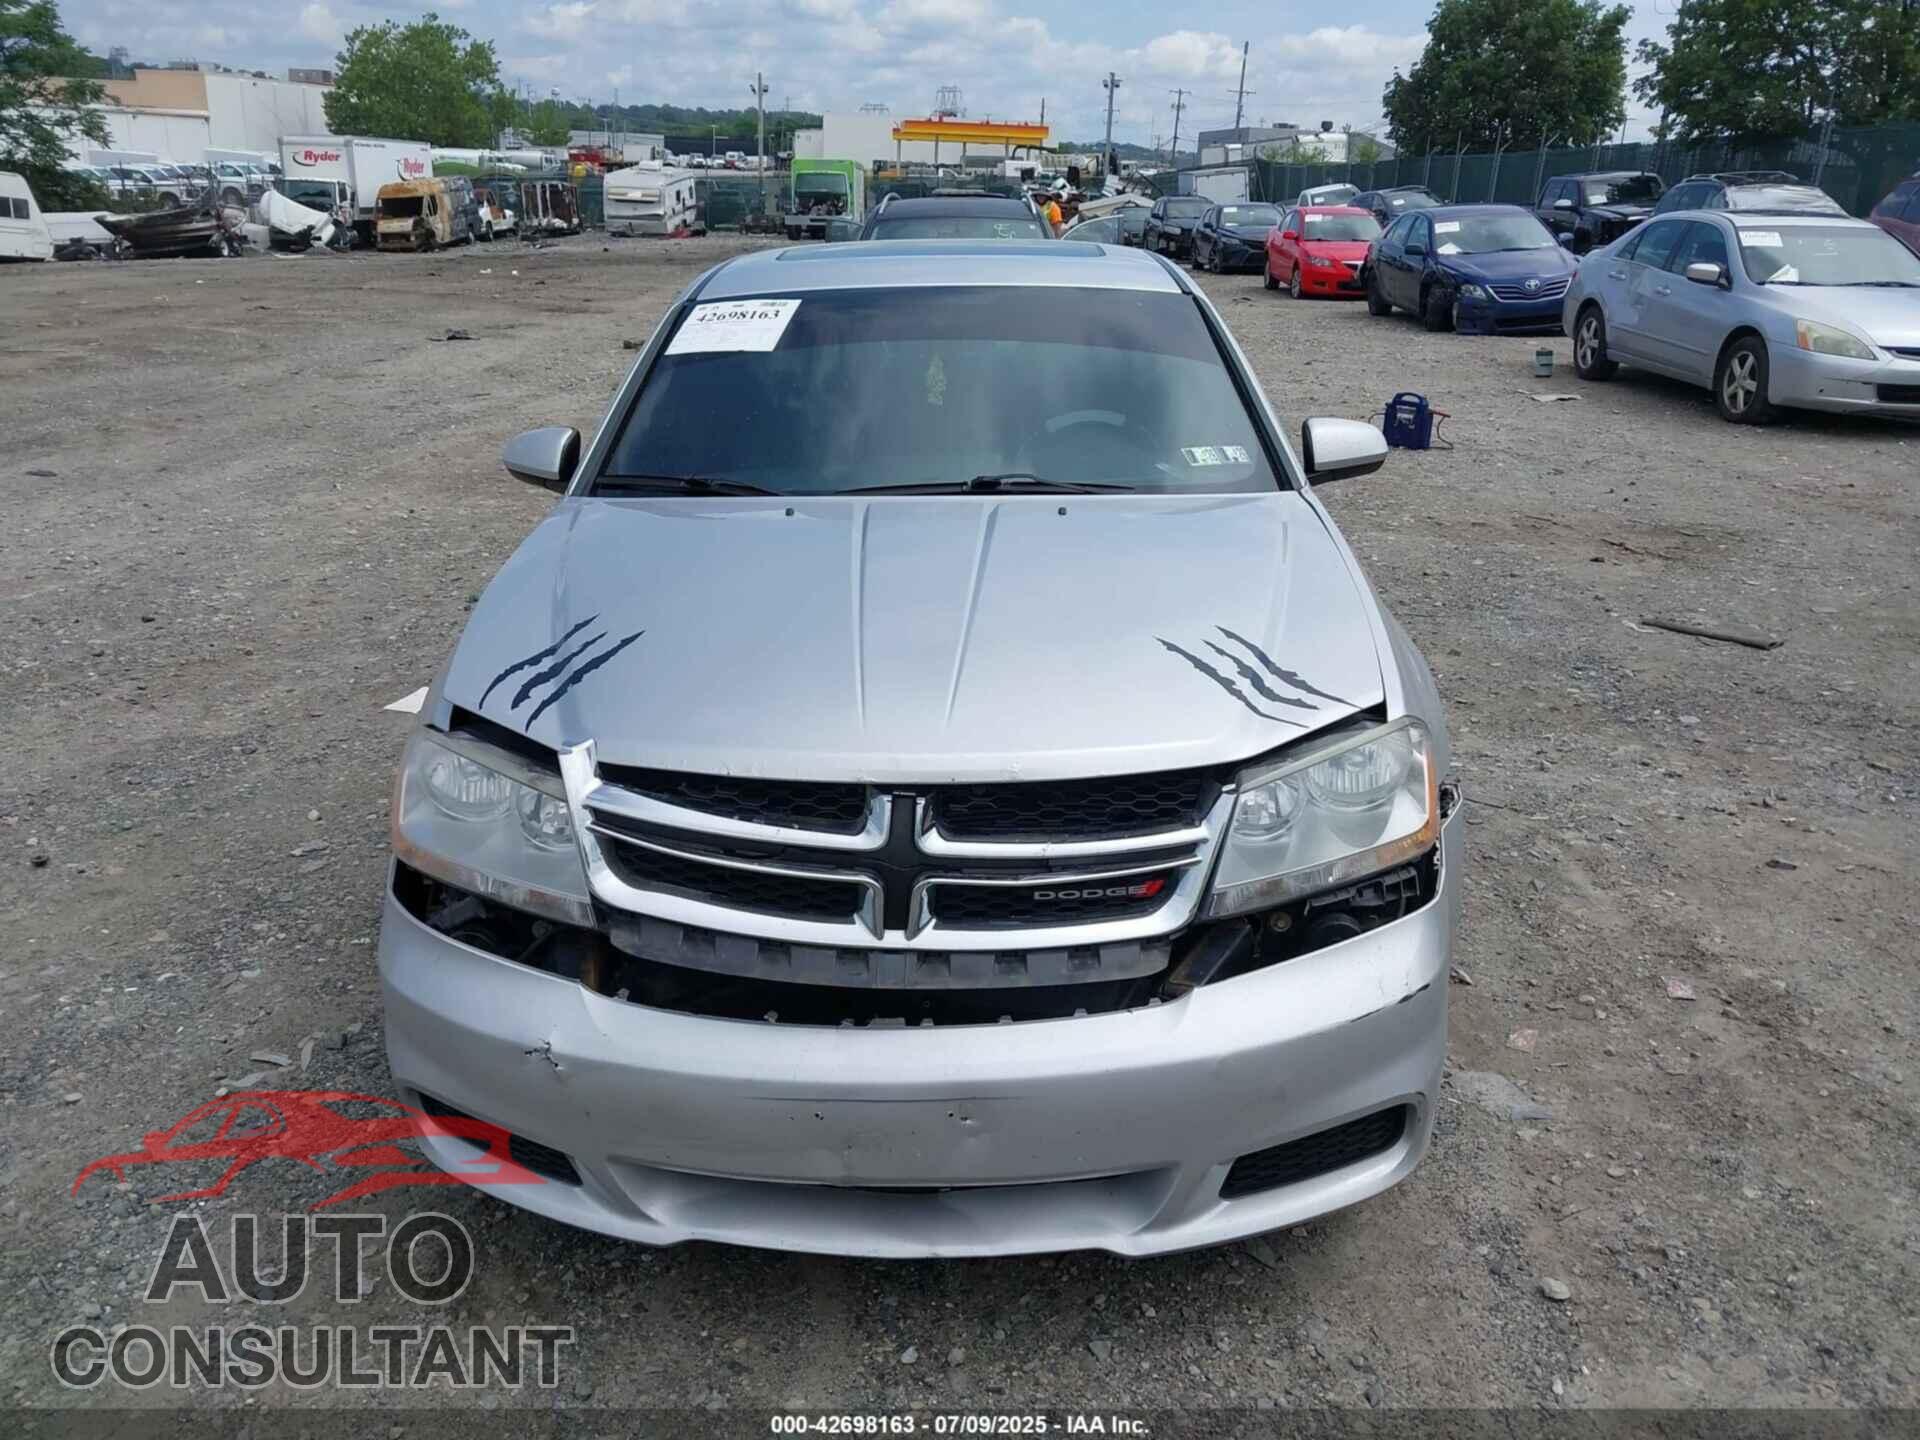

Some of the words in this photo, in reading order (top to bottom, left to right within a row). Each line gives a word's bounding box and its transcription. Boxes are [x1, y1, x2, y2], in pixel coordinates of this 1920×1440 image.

[303, 150, 341, 163] Ryder
[403, 158, 425, 174] Ryder
[697, 310, 780, 322] 42698163
[1033, 885, 1148, 900] DODGE
